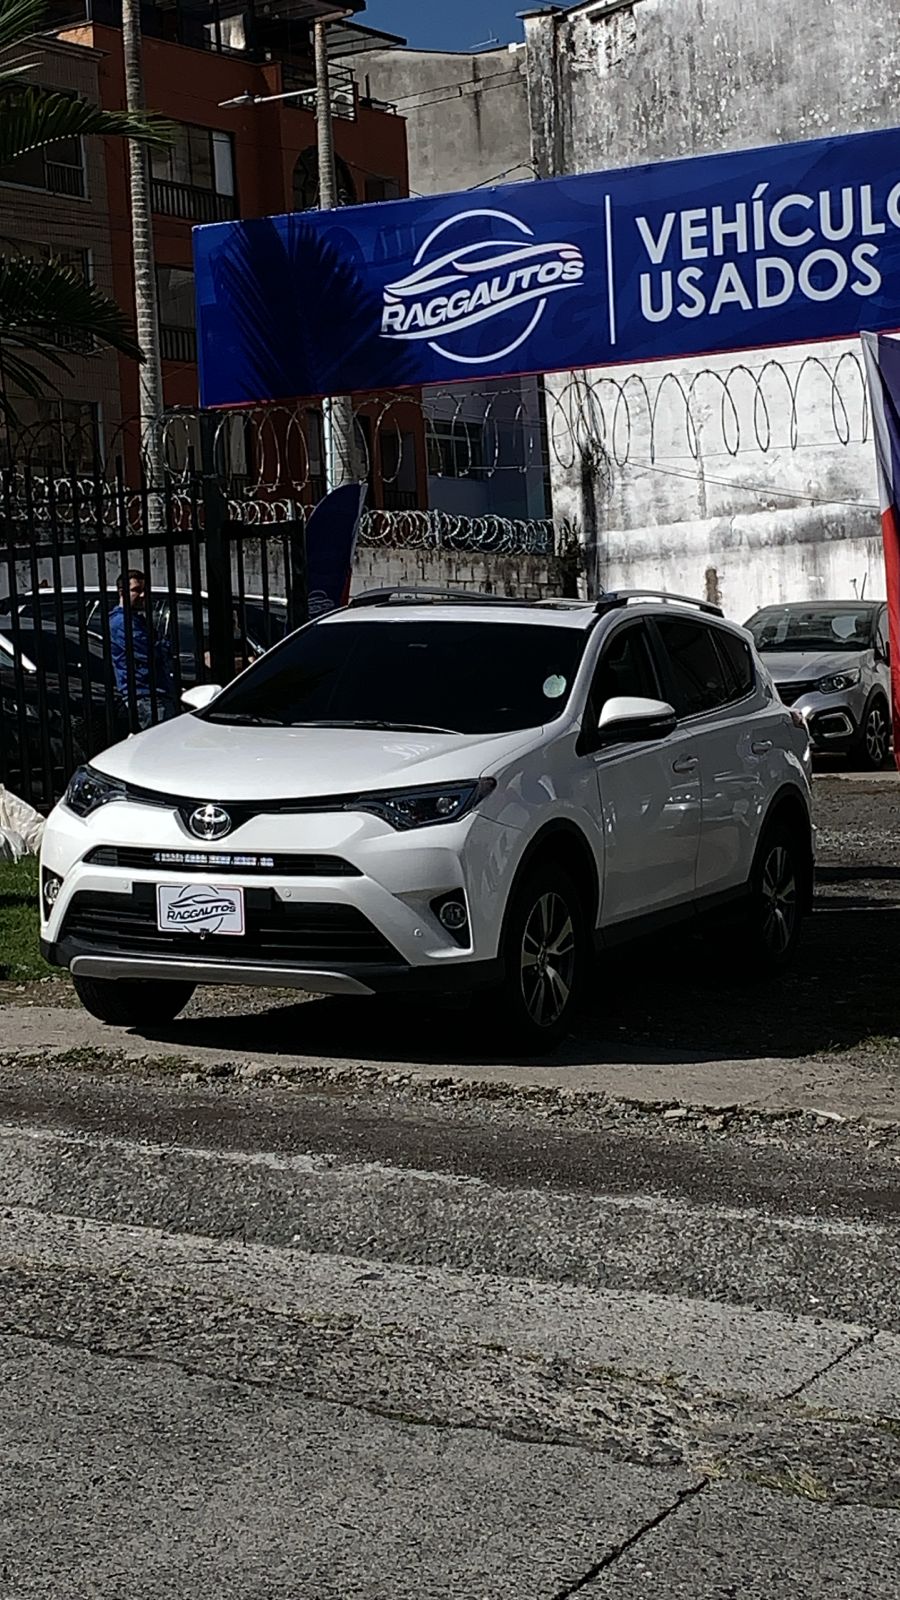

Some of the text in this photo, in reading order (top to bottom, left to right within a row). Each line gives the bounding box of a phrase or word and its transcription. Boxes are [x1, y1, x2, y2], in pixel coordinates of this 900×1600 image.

[635, 183, 900, 265] VEHÍCUL
[381, 260, 584, 332] RAGGAUTOS
[640, 243, 882, 323] USADOS
[167, 904, 236, 920] RAGGAUTOS
